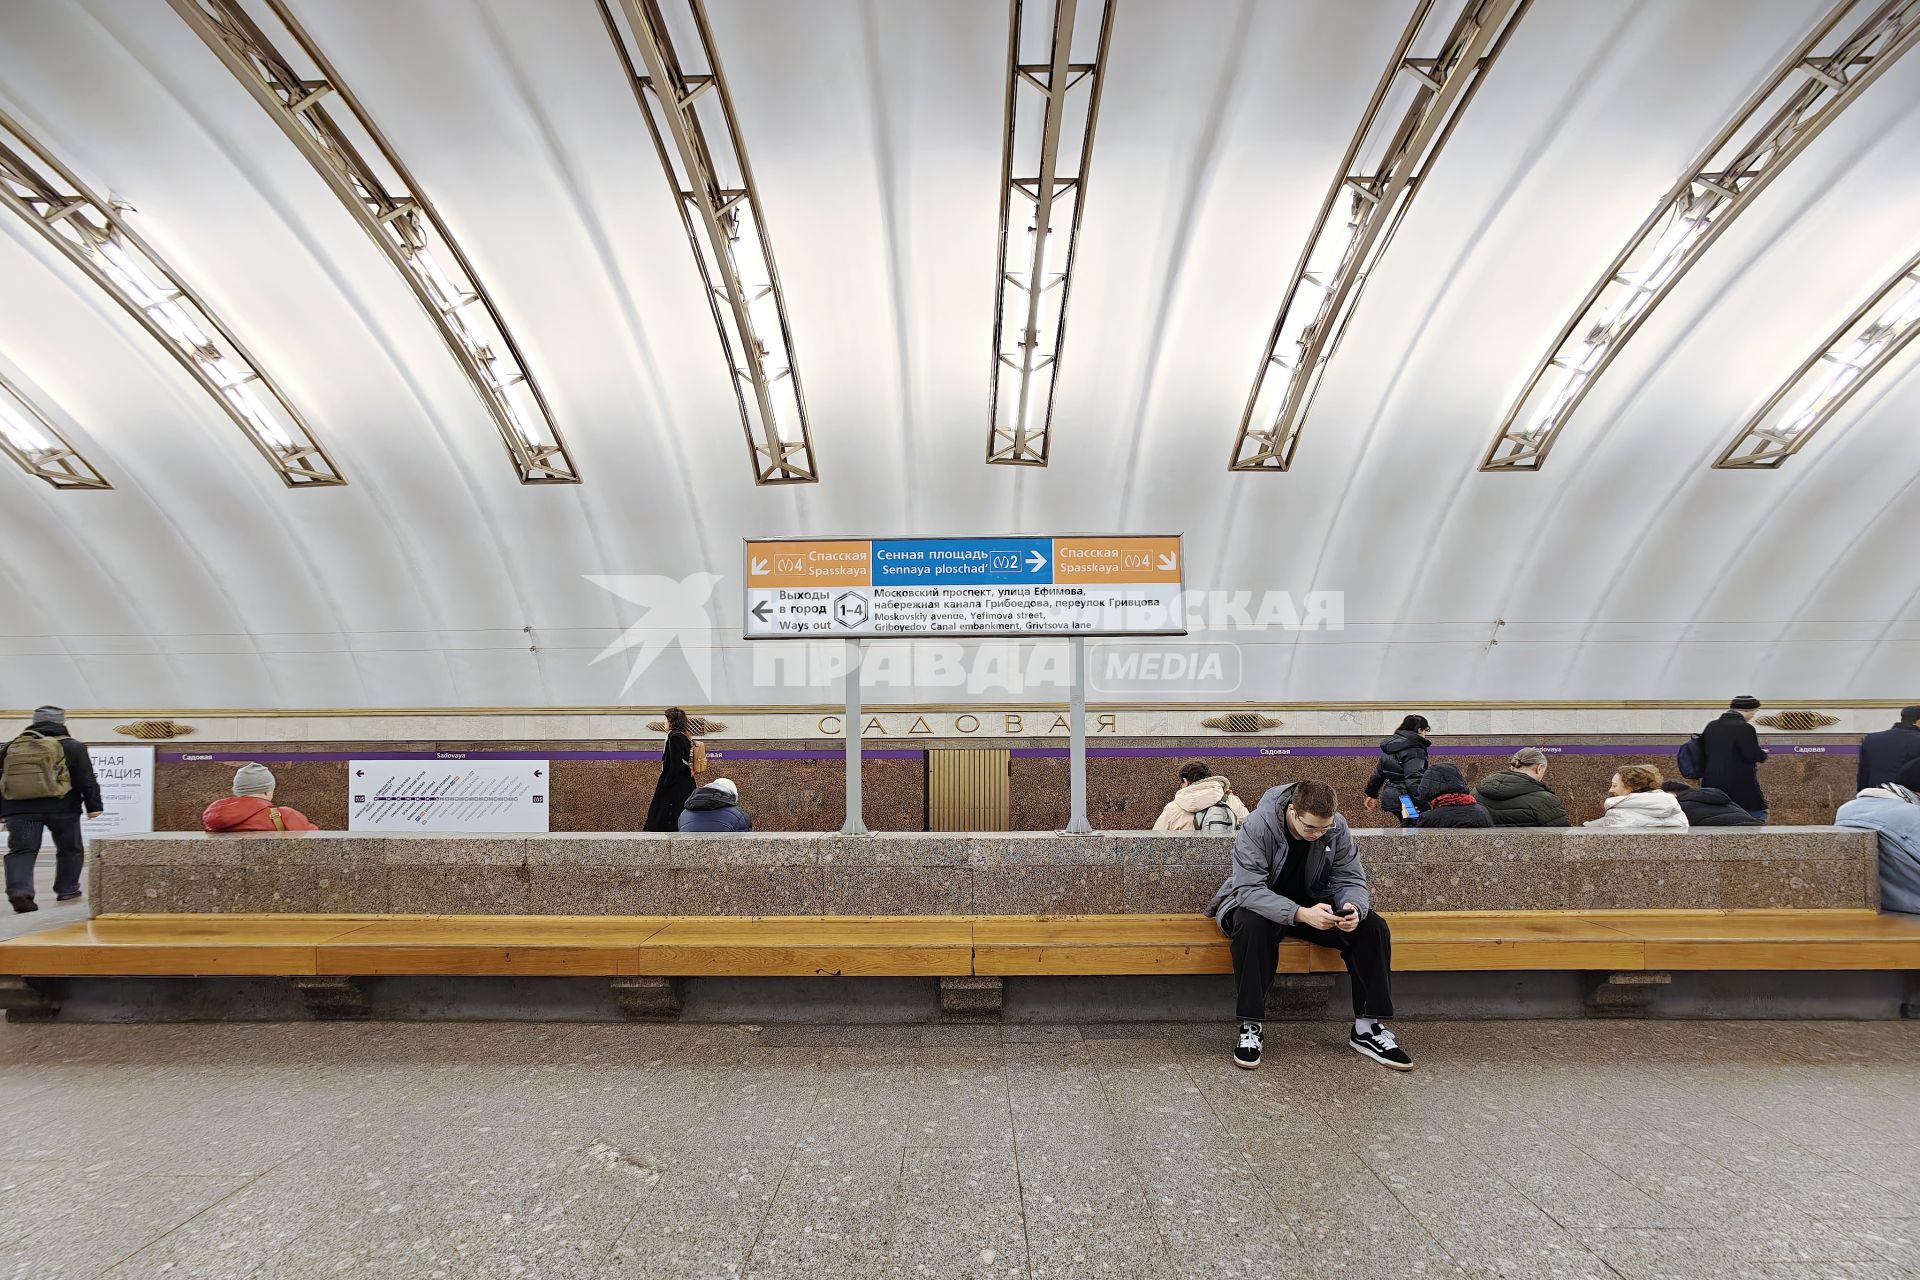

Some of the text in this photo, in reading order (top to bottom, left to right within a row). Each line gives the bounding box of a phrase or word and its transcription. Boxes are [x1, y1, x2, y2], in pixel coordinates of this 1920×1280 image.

[809, 551, 867, 561] Спасская
[877, 549, 988, 562] Сенная площадь
[1060, 547, 1119, 558] Спасская
[794, 559, 803, 571] 4
[1010, 555, 1018, 568] 2
[1142, 554, 1150, 566] 4
[809, 566, 867, 577] Spasskaya
[882, 564, 931, 576] Sennaya
[1060, 562, 1119, 574] Spasskaya
[779, 590, 830, 601] Выходы
[874, 587, 1086, 599] Московский проспект, улица Ефимова,
[874, 598, 1160, 609] набережная канала Грибоедова, переулок Гривцова
[779, 605, 827, 616] в город
[874, 611, 1046, 622] Moskovskiy avenue, Yefimova street,
[779, 621, 832, 632] Ways out
[874, 620, 1092, 632] Griboyedov Canal embankment, Grivtsova lane
[818, 713, 1116, 735] САДОВАЯ
[1260, 748, 1291, 756] Садовая
[1793, 745, 1826, 754] Садовая
[182, 753, 213, 762] Садовая
[436, 752, 466, 760] Sadovaya
